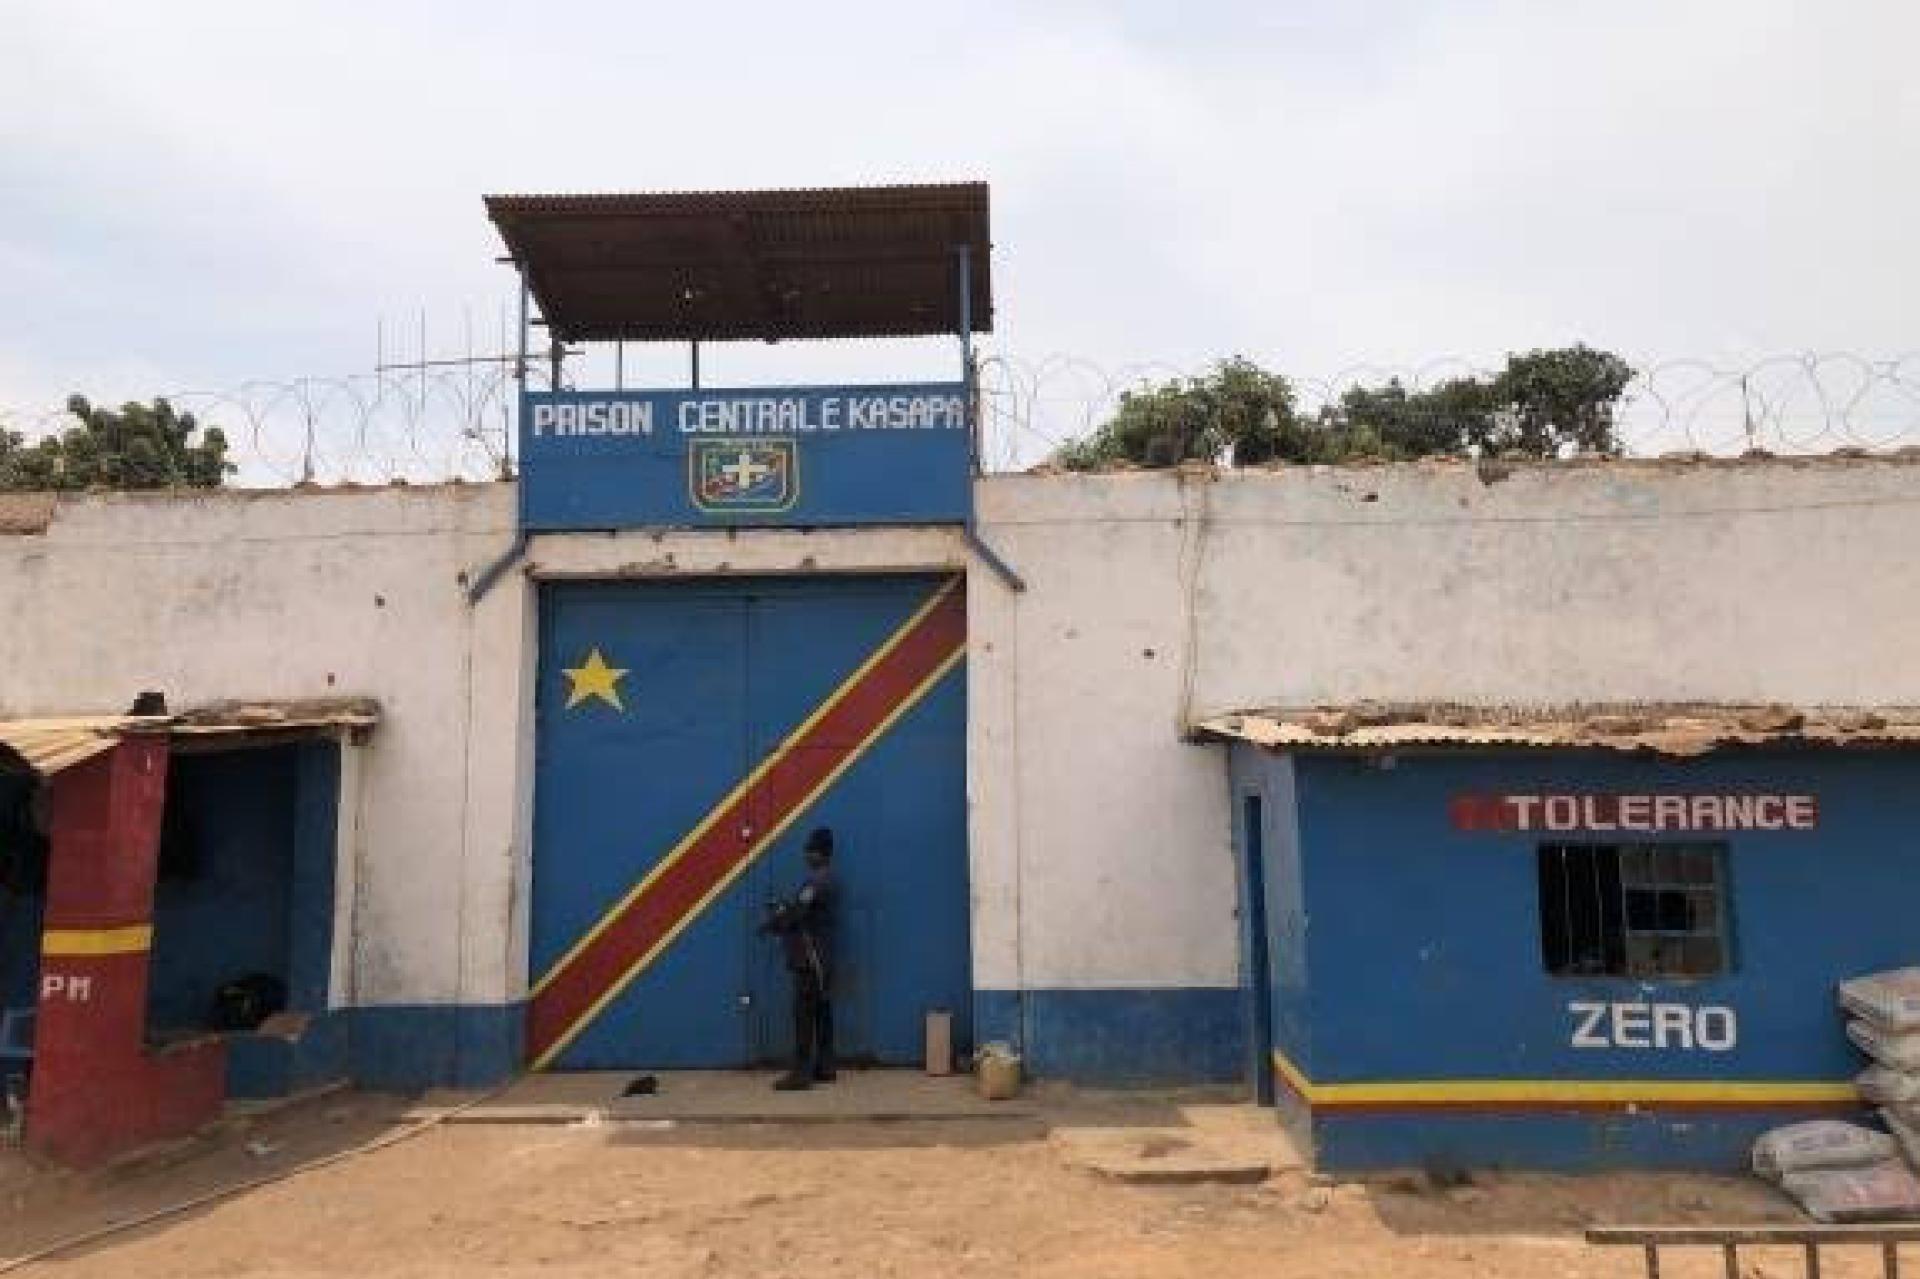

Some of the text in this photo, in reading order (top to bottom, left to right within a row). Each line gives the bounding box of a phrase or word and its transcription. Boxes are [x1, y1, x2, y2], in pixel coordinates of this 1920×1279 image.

[533, 397, 964, 435] PRISON CENTRALE KASAPA
[1505, 796, 1814, 831] TOLERANCE
[42, 976, 91, 1001] PM
